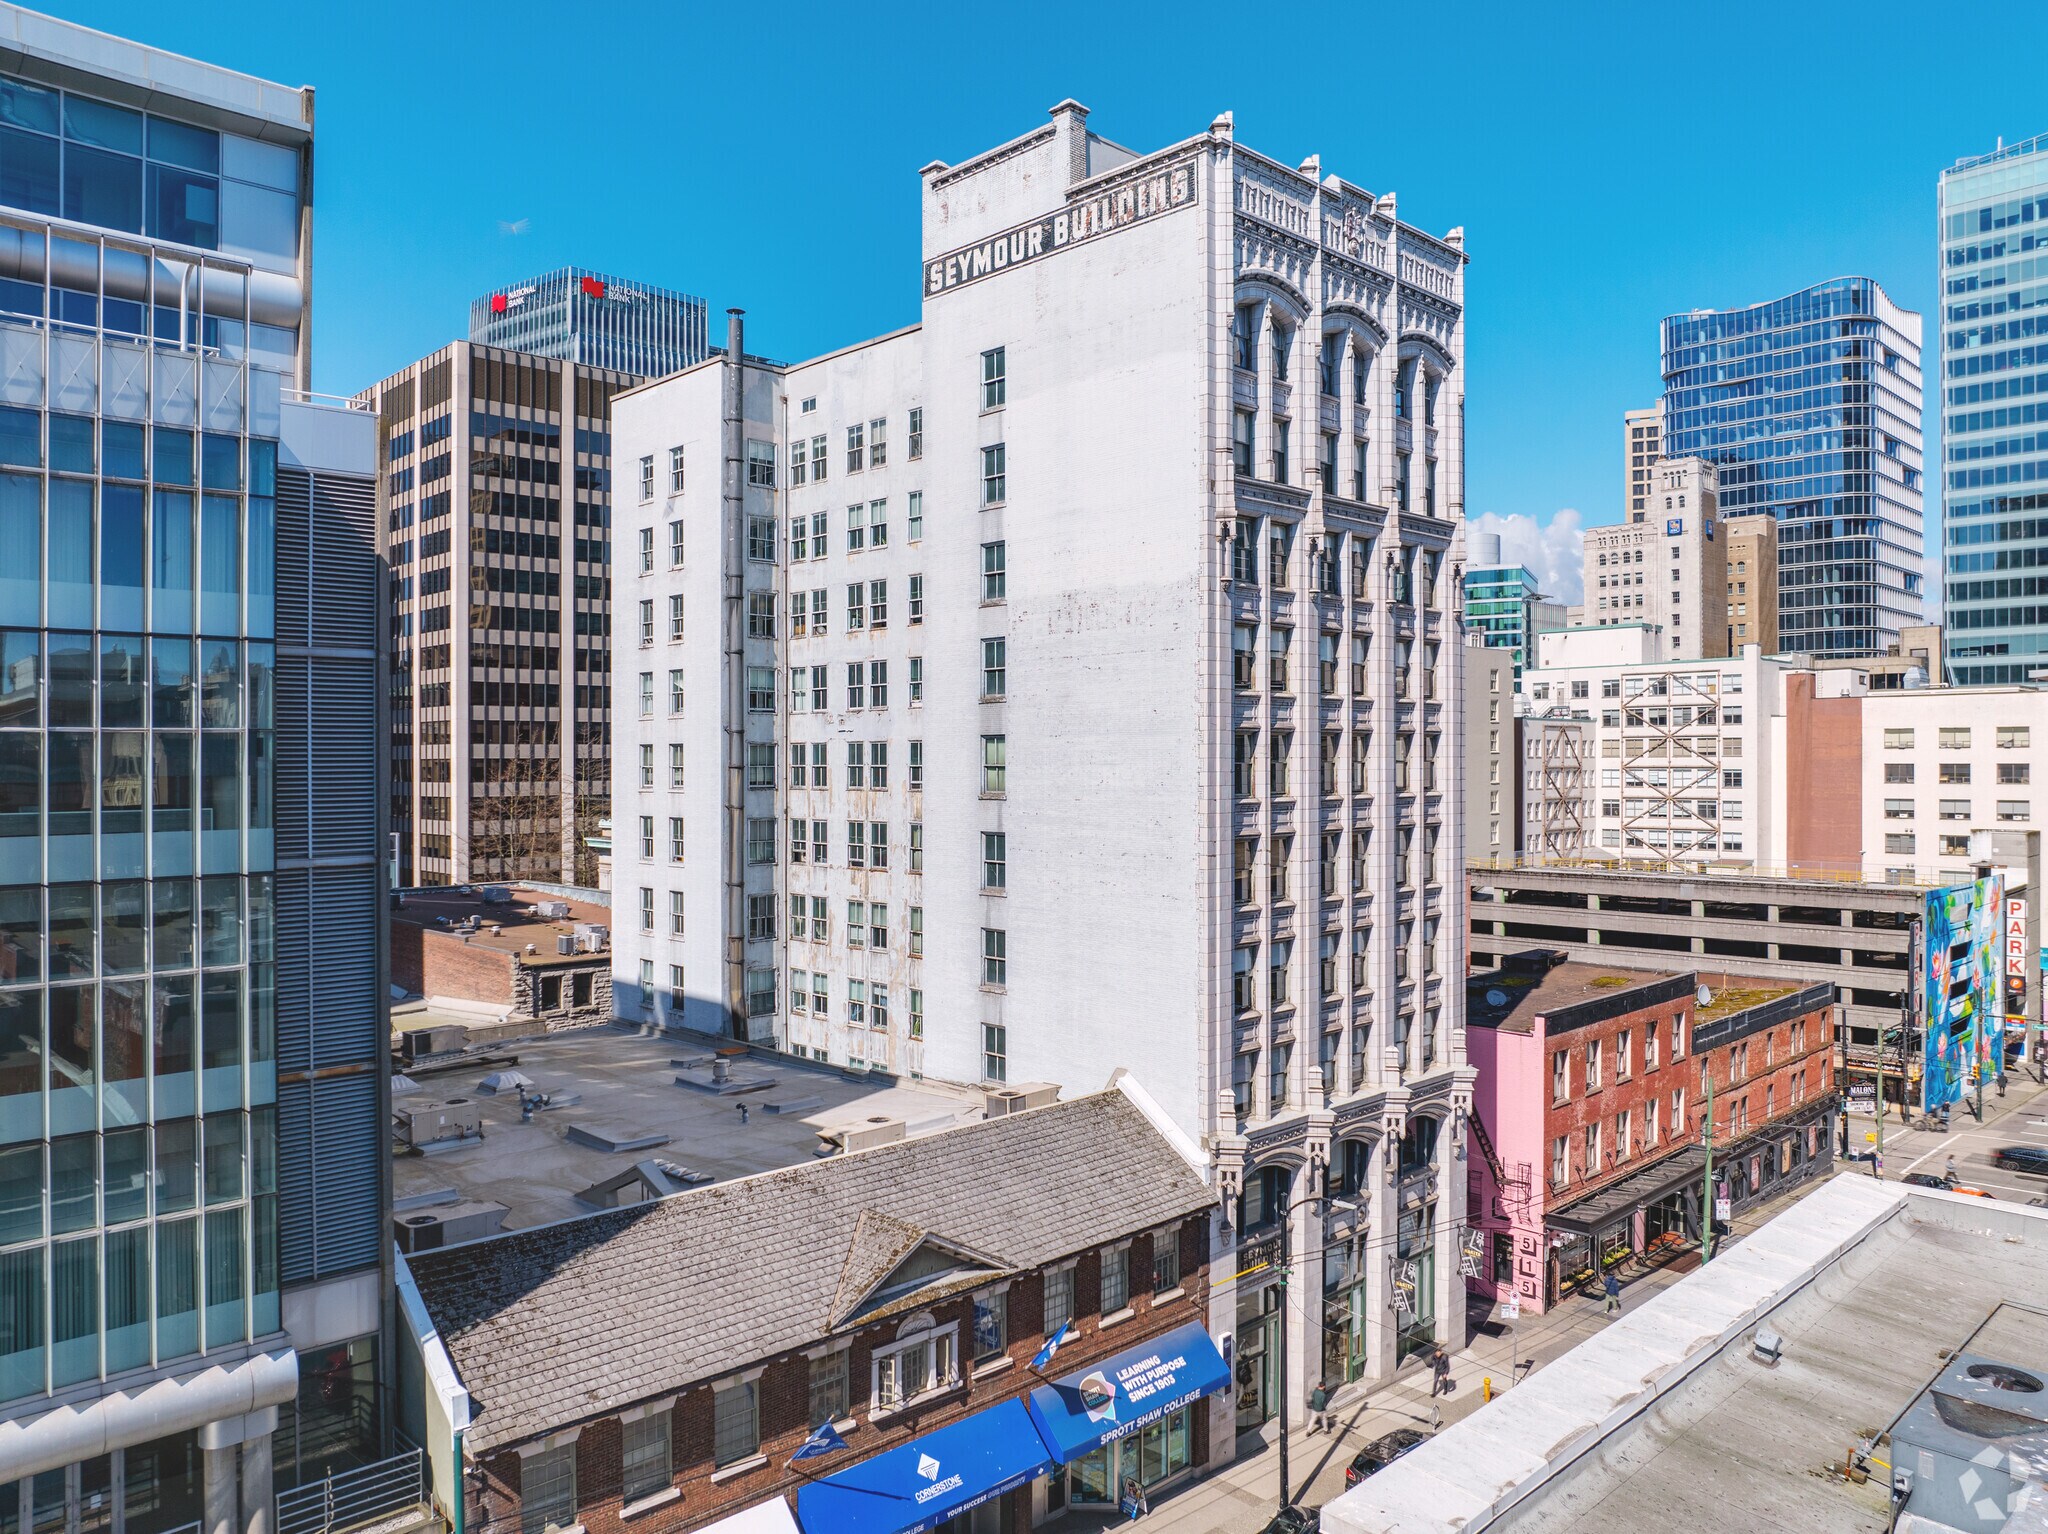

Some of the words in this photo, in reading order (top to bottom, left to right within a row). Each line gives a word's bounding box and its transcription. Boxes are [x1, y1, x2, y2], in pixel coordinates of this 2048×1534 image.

[929, 223, 1043, 293] SEYMOUR
[1054, 168, 1189, 248] BUILDING
[508, 285, 536, 299] NATIONAL
[508, 297, 525, 308] BANK
[608, 291, 630, 304] BANK
[609, 284, 648, 300] NATIONAL
[2008, 901, 2023, 974] PARK
[1116, 1355, 1161, 1381] LEARNING
[1122, 1374, 1148, 1392] WITH
[1146, 1356, 1187, 1381] PURPOSE
[1128, 1383, 1156, 1403] SINCE
[1154, 1374, 1176, 1390] 1903
[1100, 1420, 1136, 1445] SPROTT
[1136, 1406, 1163, 1428] SHAW
[1163, 1388, 1201, 1414] COLLEGE
[915, 1473, 963, 1501] CORNERSTONE
[947, 1506, 963, 1518] YOUR
[963, 1494, 987, 1511] SUCCESS
